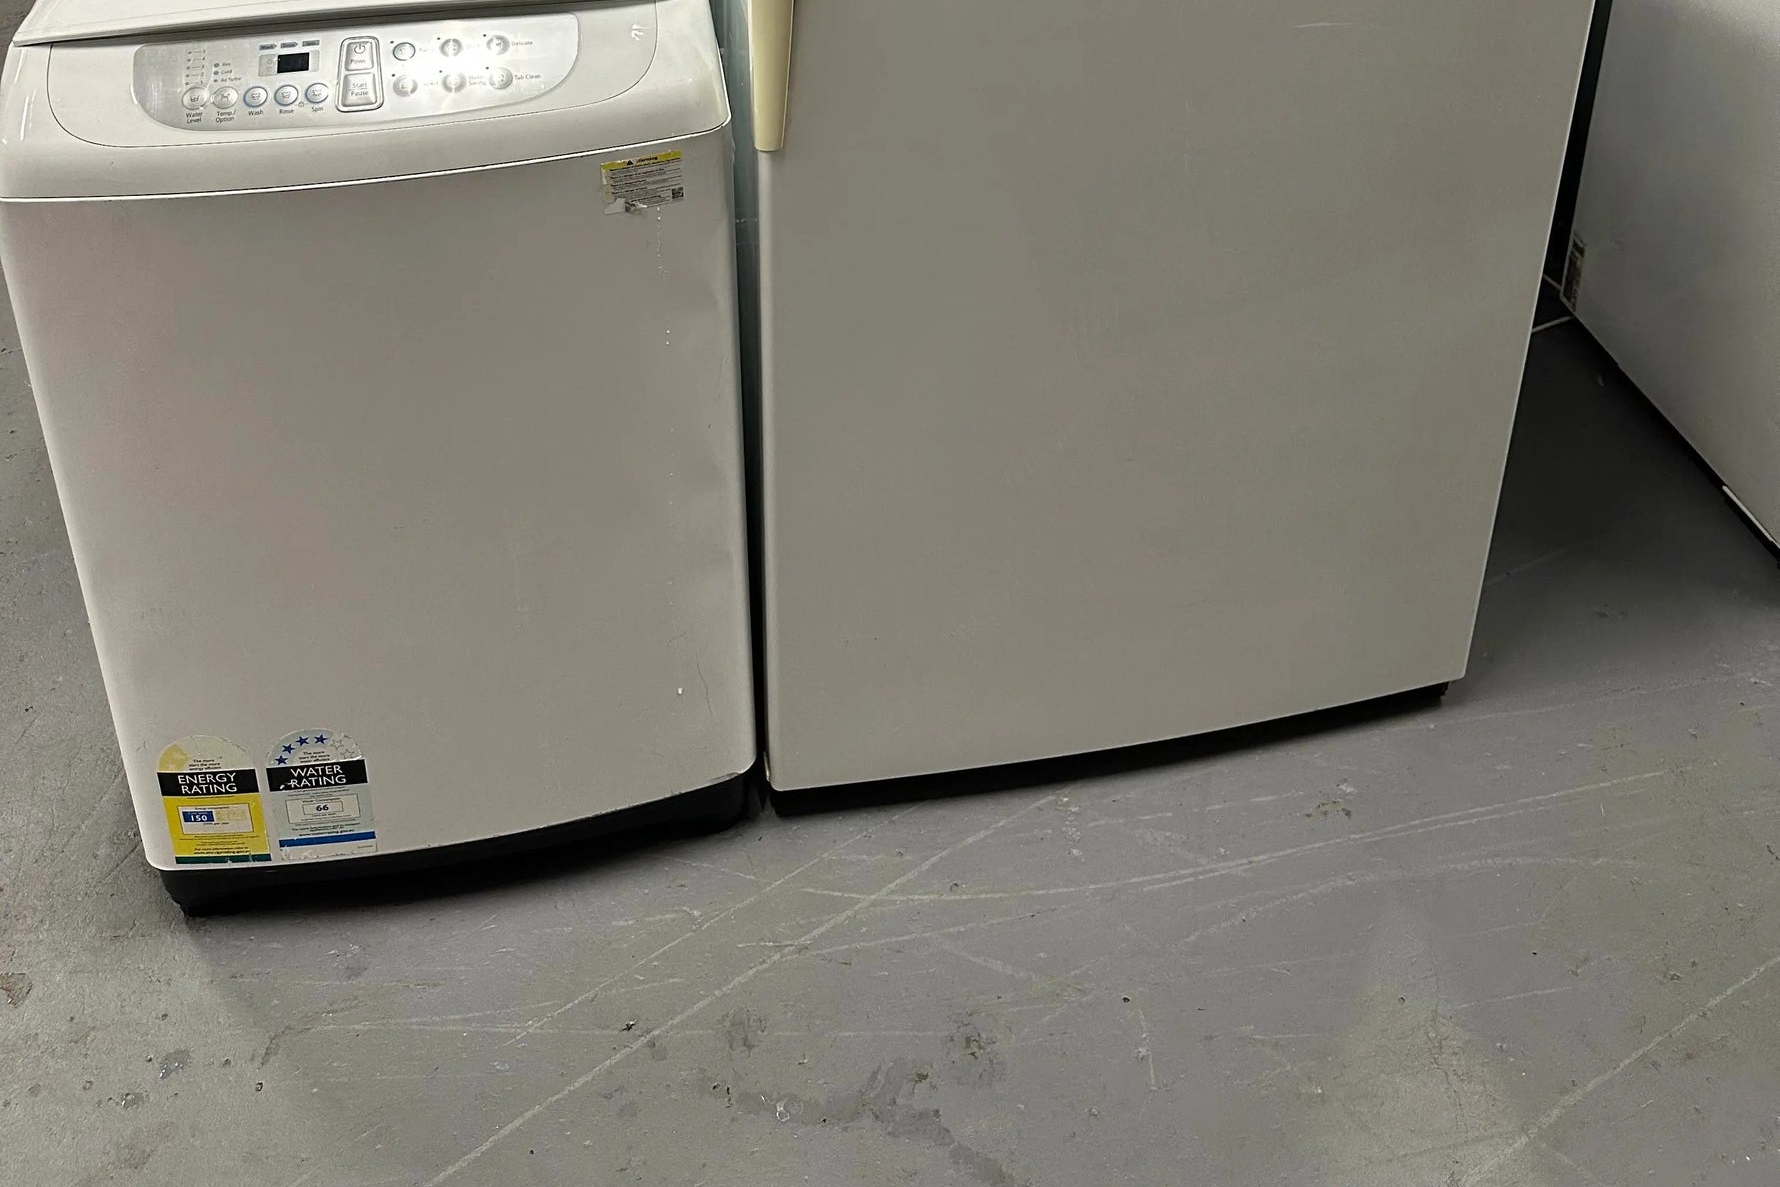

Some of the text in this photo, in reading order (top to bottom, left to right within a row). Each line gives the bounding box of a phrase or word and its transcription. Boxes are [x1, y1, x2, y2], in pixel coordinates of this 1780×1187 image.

[311, 106, 324, 114] Spin
[215, 116, 234, 124] Option
[290, 765, 343, 777] WATER
[177, 772, 237, 784] ENERGY
[290, 774, 347, 788] RATING
[181, 783, 238, 794] RATING
[316, 804, 329, 812] 66
[191, 814, 208, 822] 150
